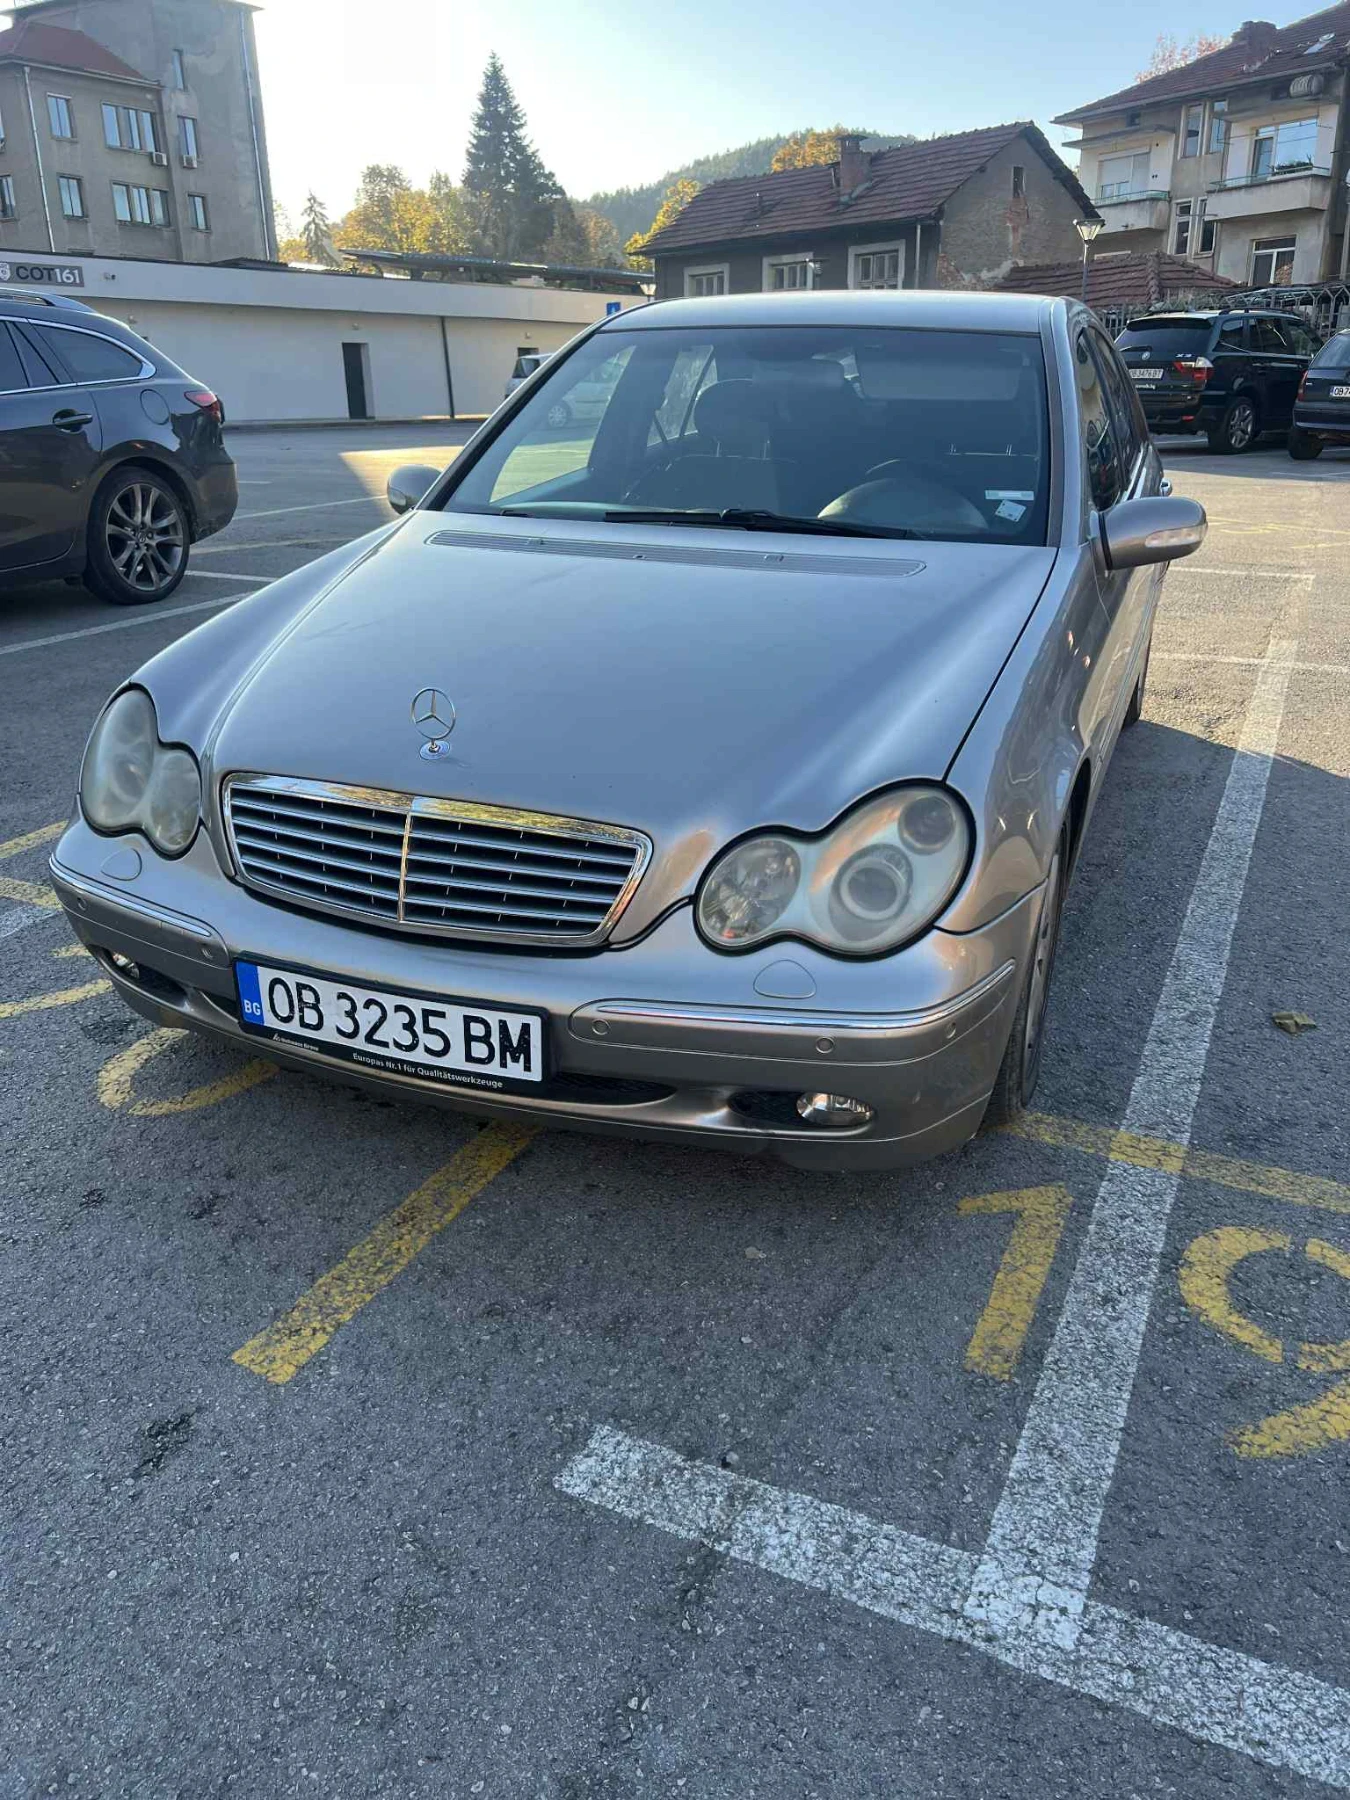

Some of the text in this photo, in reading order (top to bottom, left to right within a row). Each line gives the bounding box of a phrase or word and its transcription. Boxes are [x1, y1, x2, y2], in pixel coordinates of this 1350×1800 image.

[243, 999, 261, 1016] BG
[268, 977, 532, 1073] OB 3235 BM
[352, 1052, 385, 1068] Europas
[403, 1063, 416, 1074] für
[417, 1067, 503, 1089] Qualitätswerkzeuge
